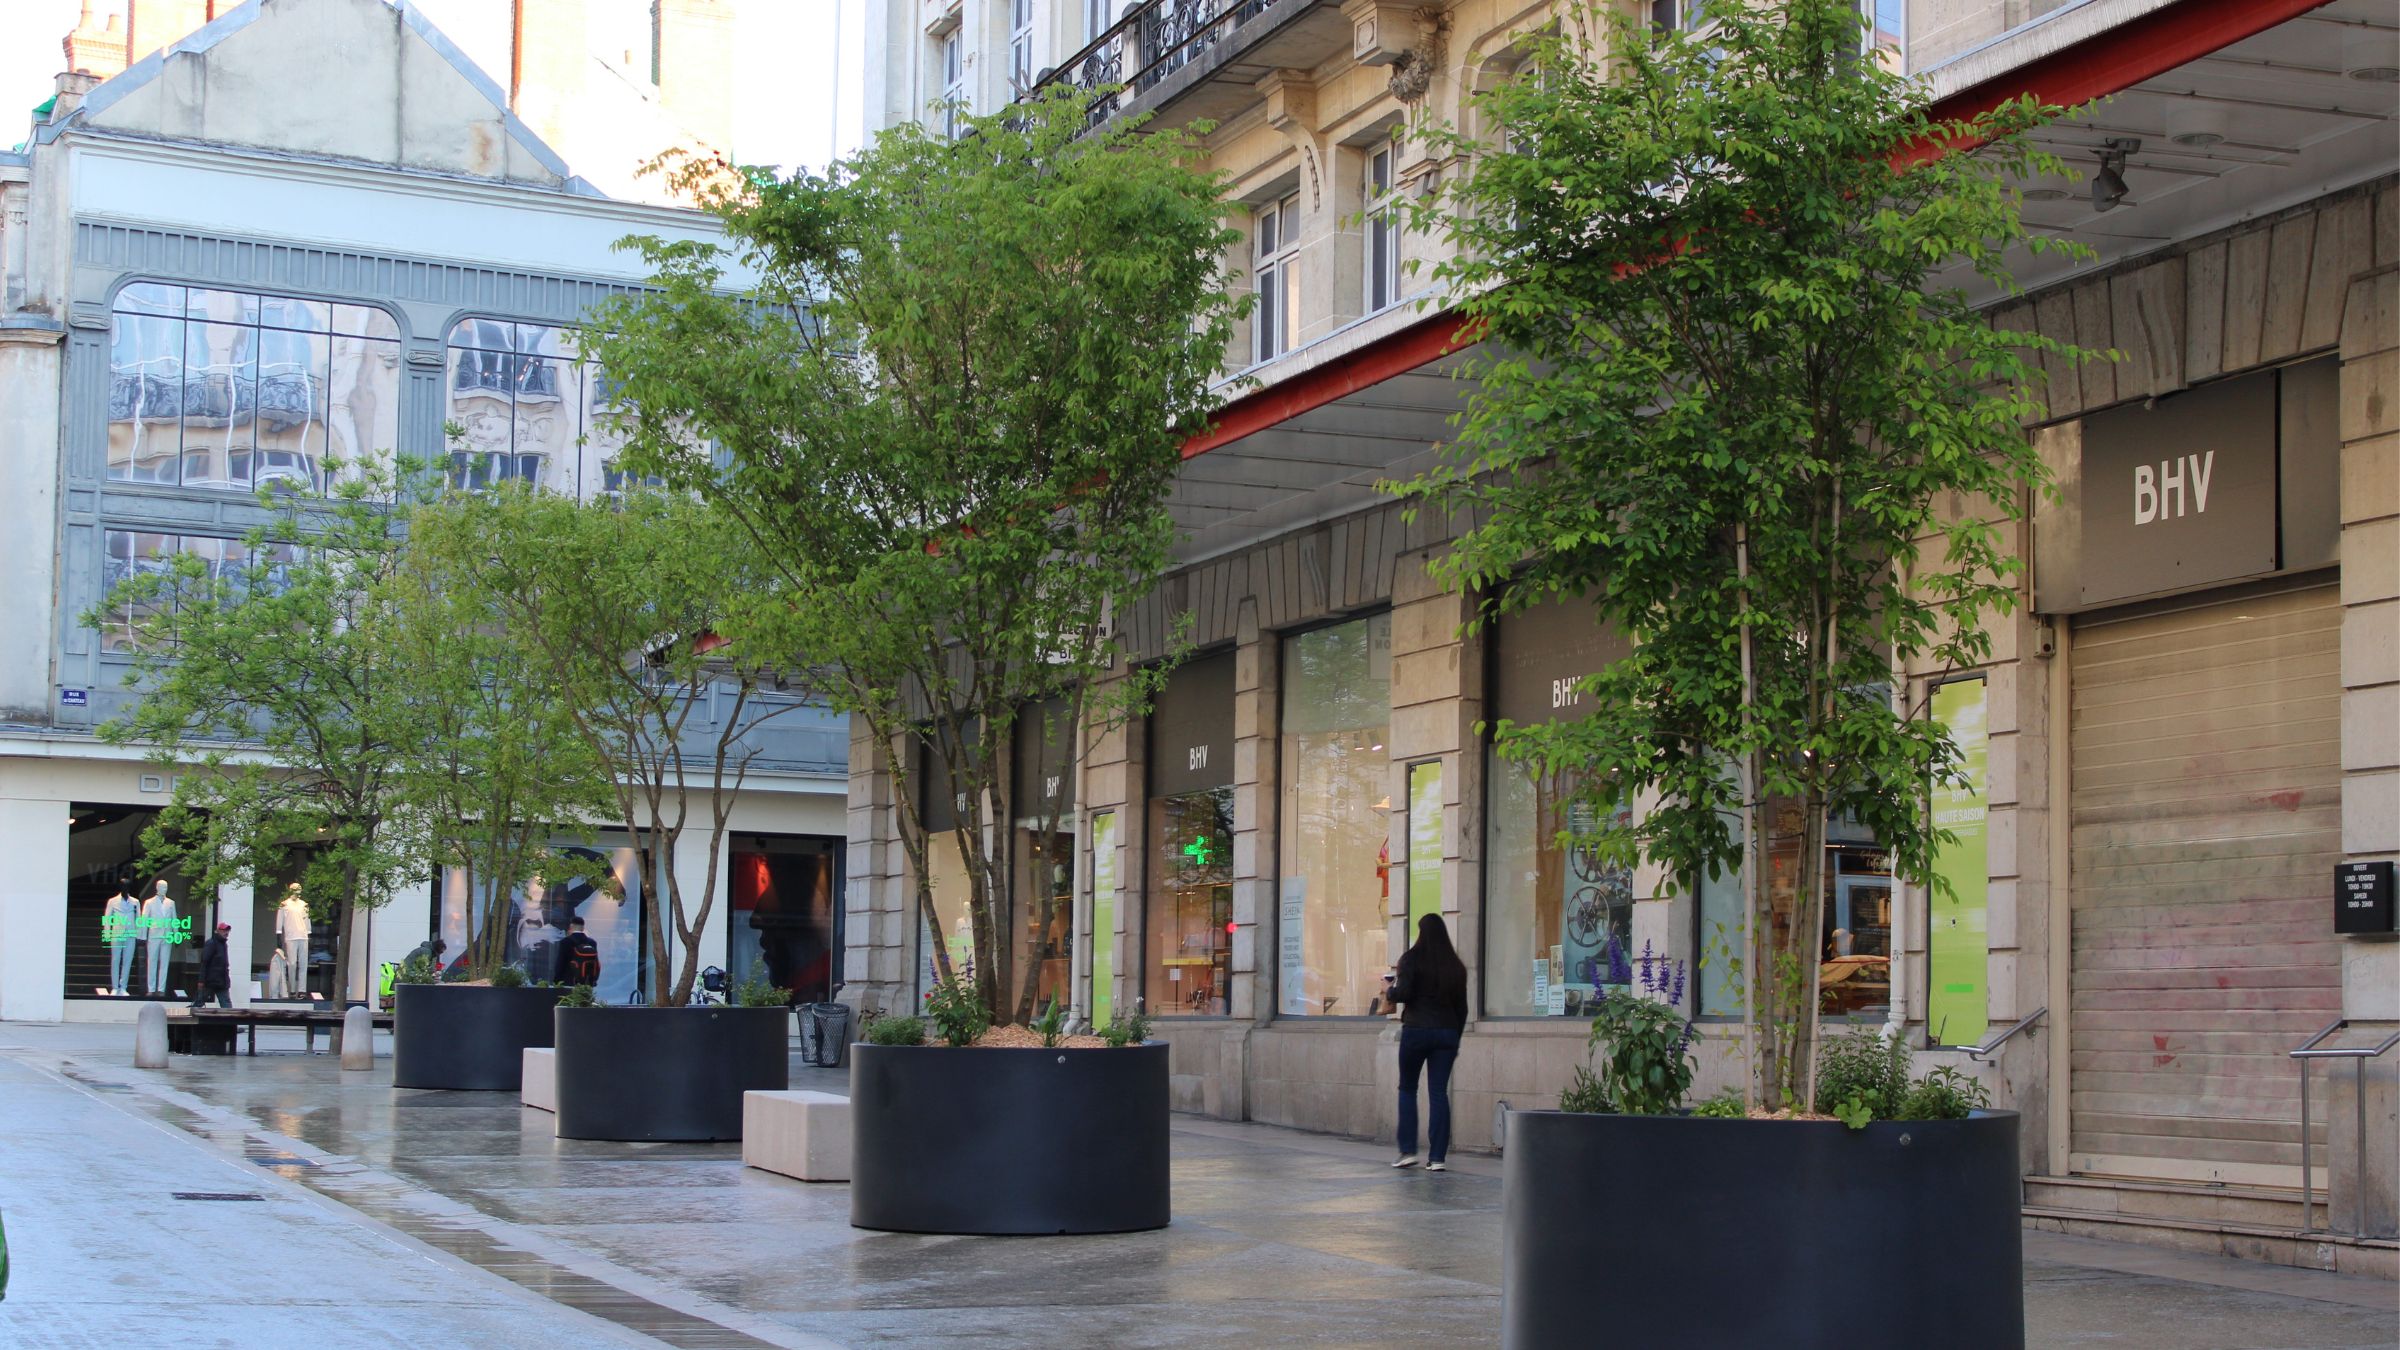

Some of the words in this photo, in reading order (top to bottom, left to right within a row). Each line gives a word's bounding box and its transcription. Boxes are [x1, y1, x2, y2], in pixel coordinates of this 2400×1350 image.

[2135, 450, 2214, 525] BHV
[1190, 745, 1209, 771] BHV
[956, 791, 967, 812] HV
[1936, 809, 1957, 824] HAUTE
[1958, 807, 1984, 822] SAISON
[2358, 874, 2376, 882] VENDREDI
